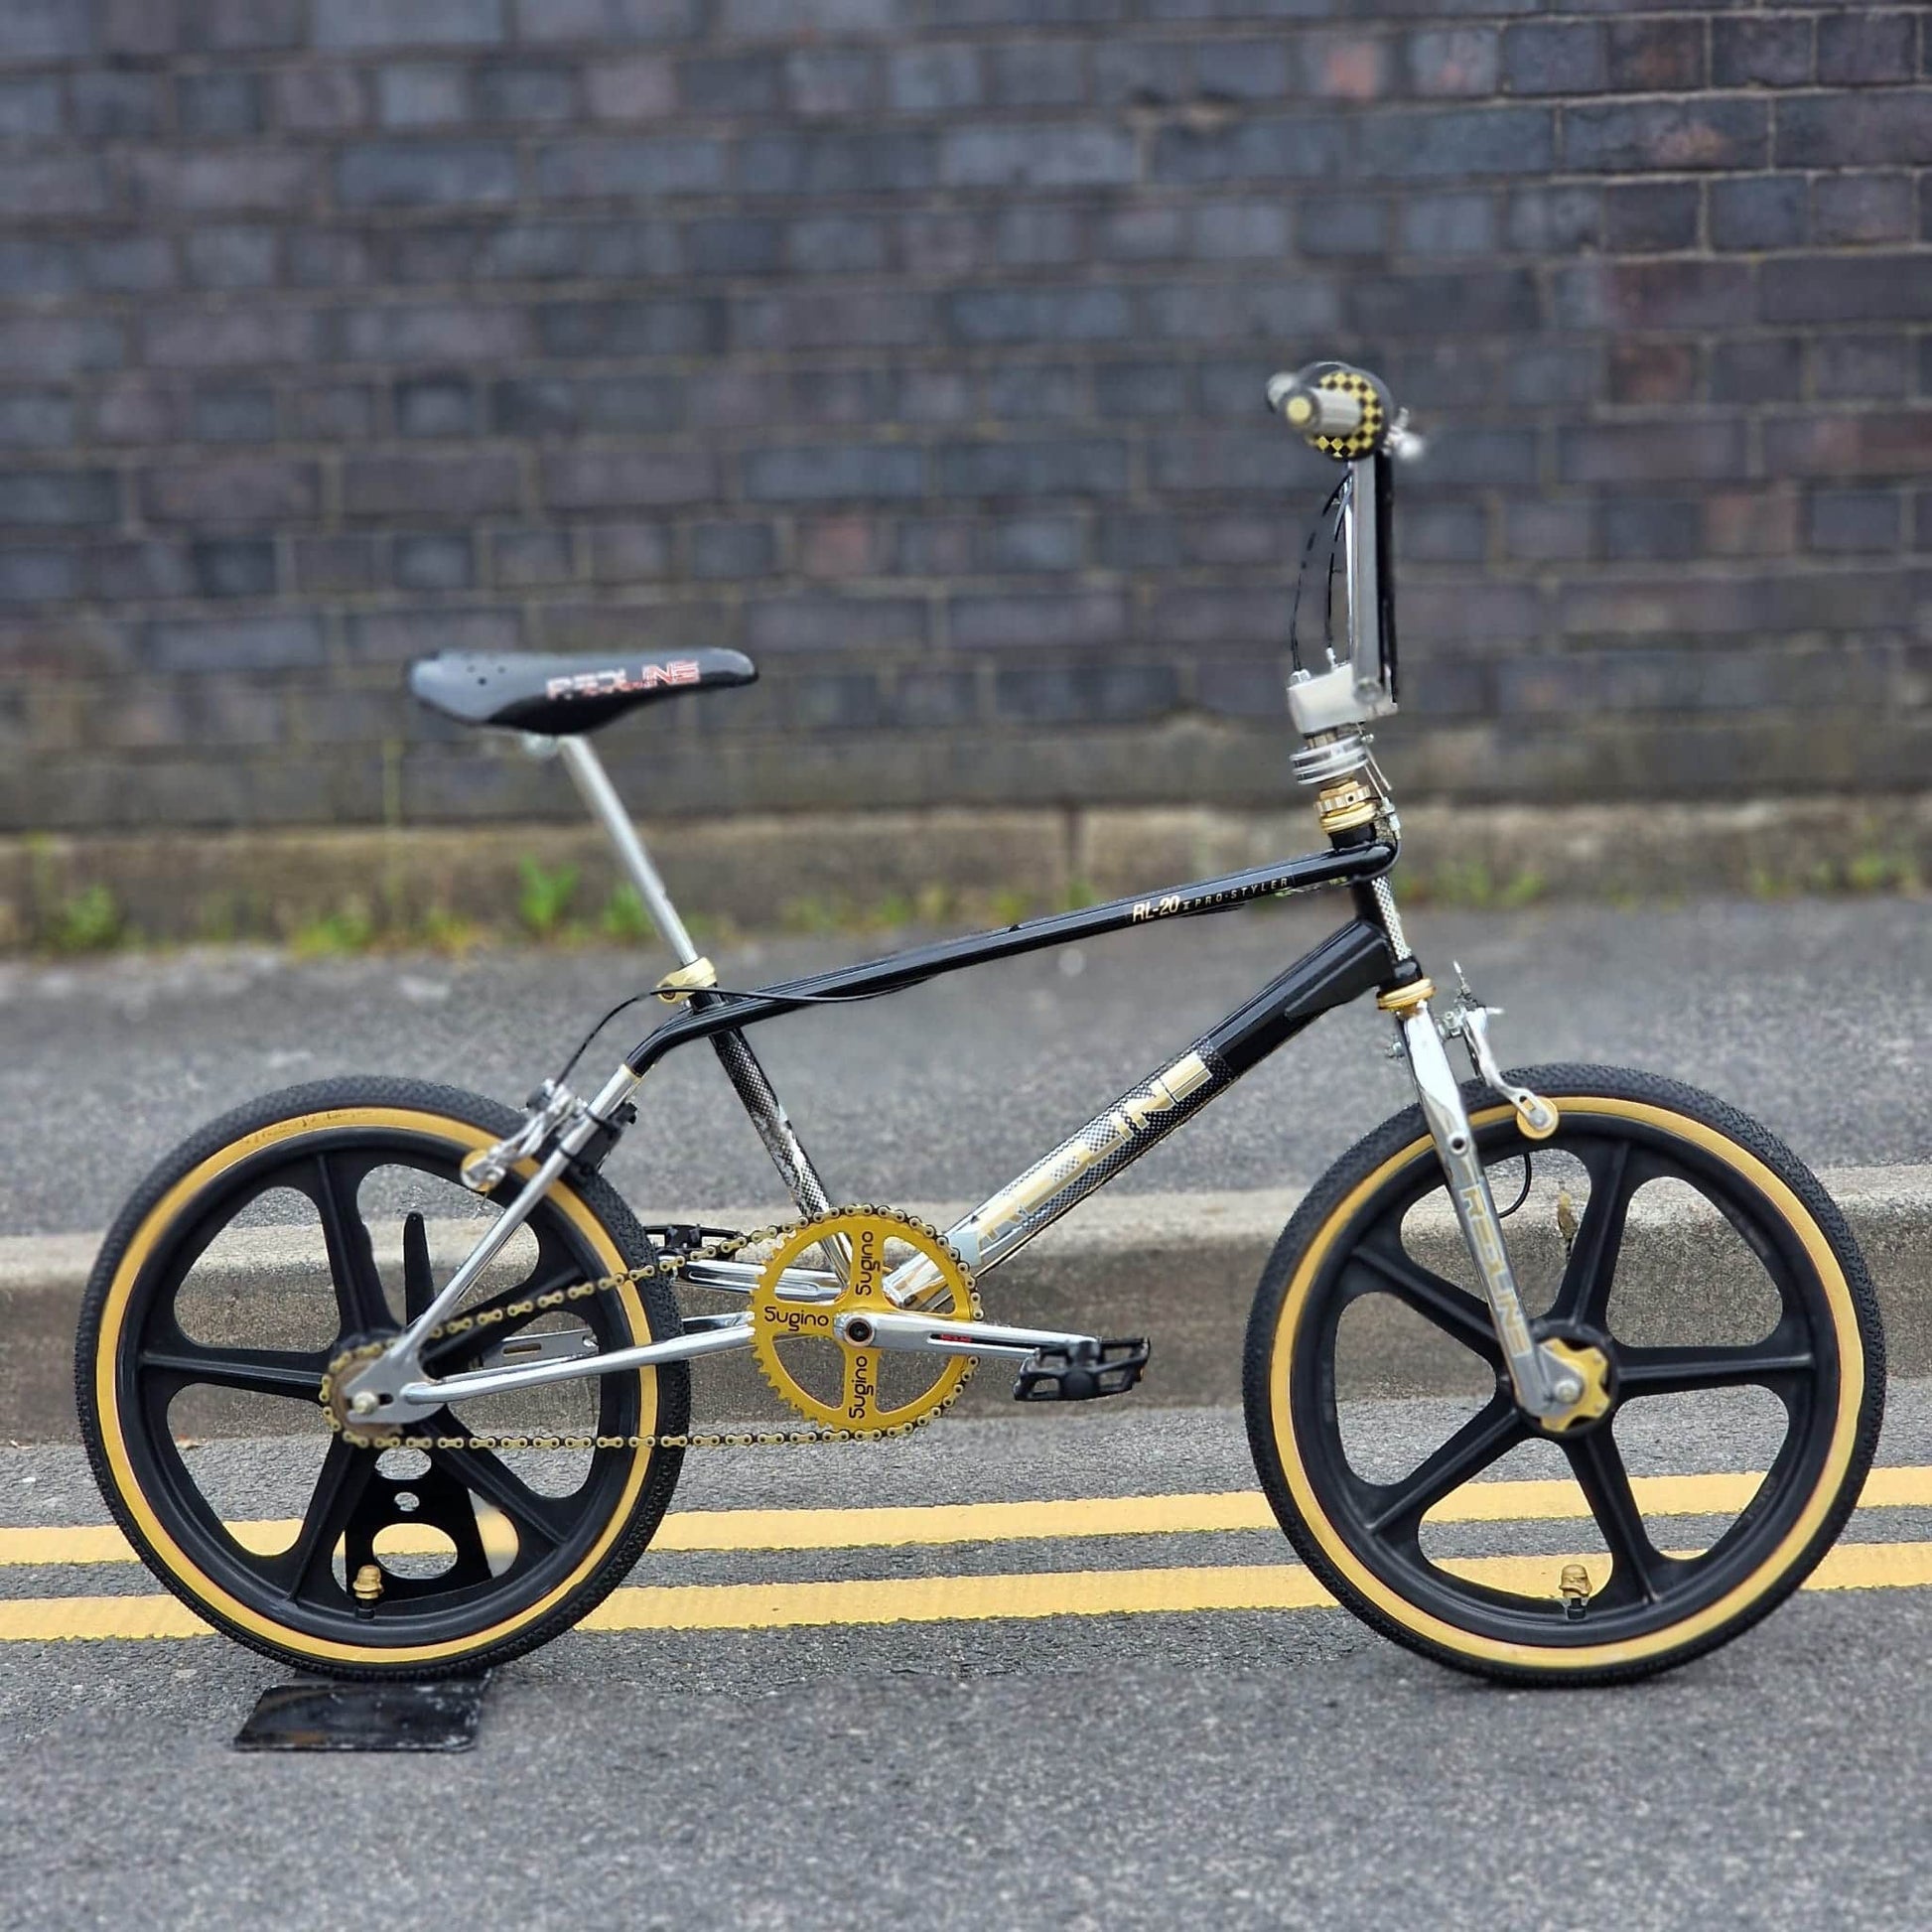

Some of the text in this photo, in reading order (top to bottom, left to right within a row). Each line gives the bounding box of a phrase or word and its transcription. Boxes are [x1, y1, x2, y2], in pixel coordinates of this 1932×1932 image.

[1132, 895, 1180, 922] RL-20
[855, 1231, 881, 1296] Sugino
[763, 1306, 829, 1332] Sugino
[848, 1356, 874, 1419] Sugino
